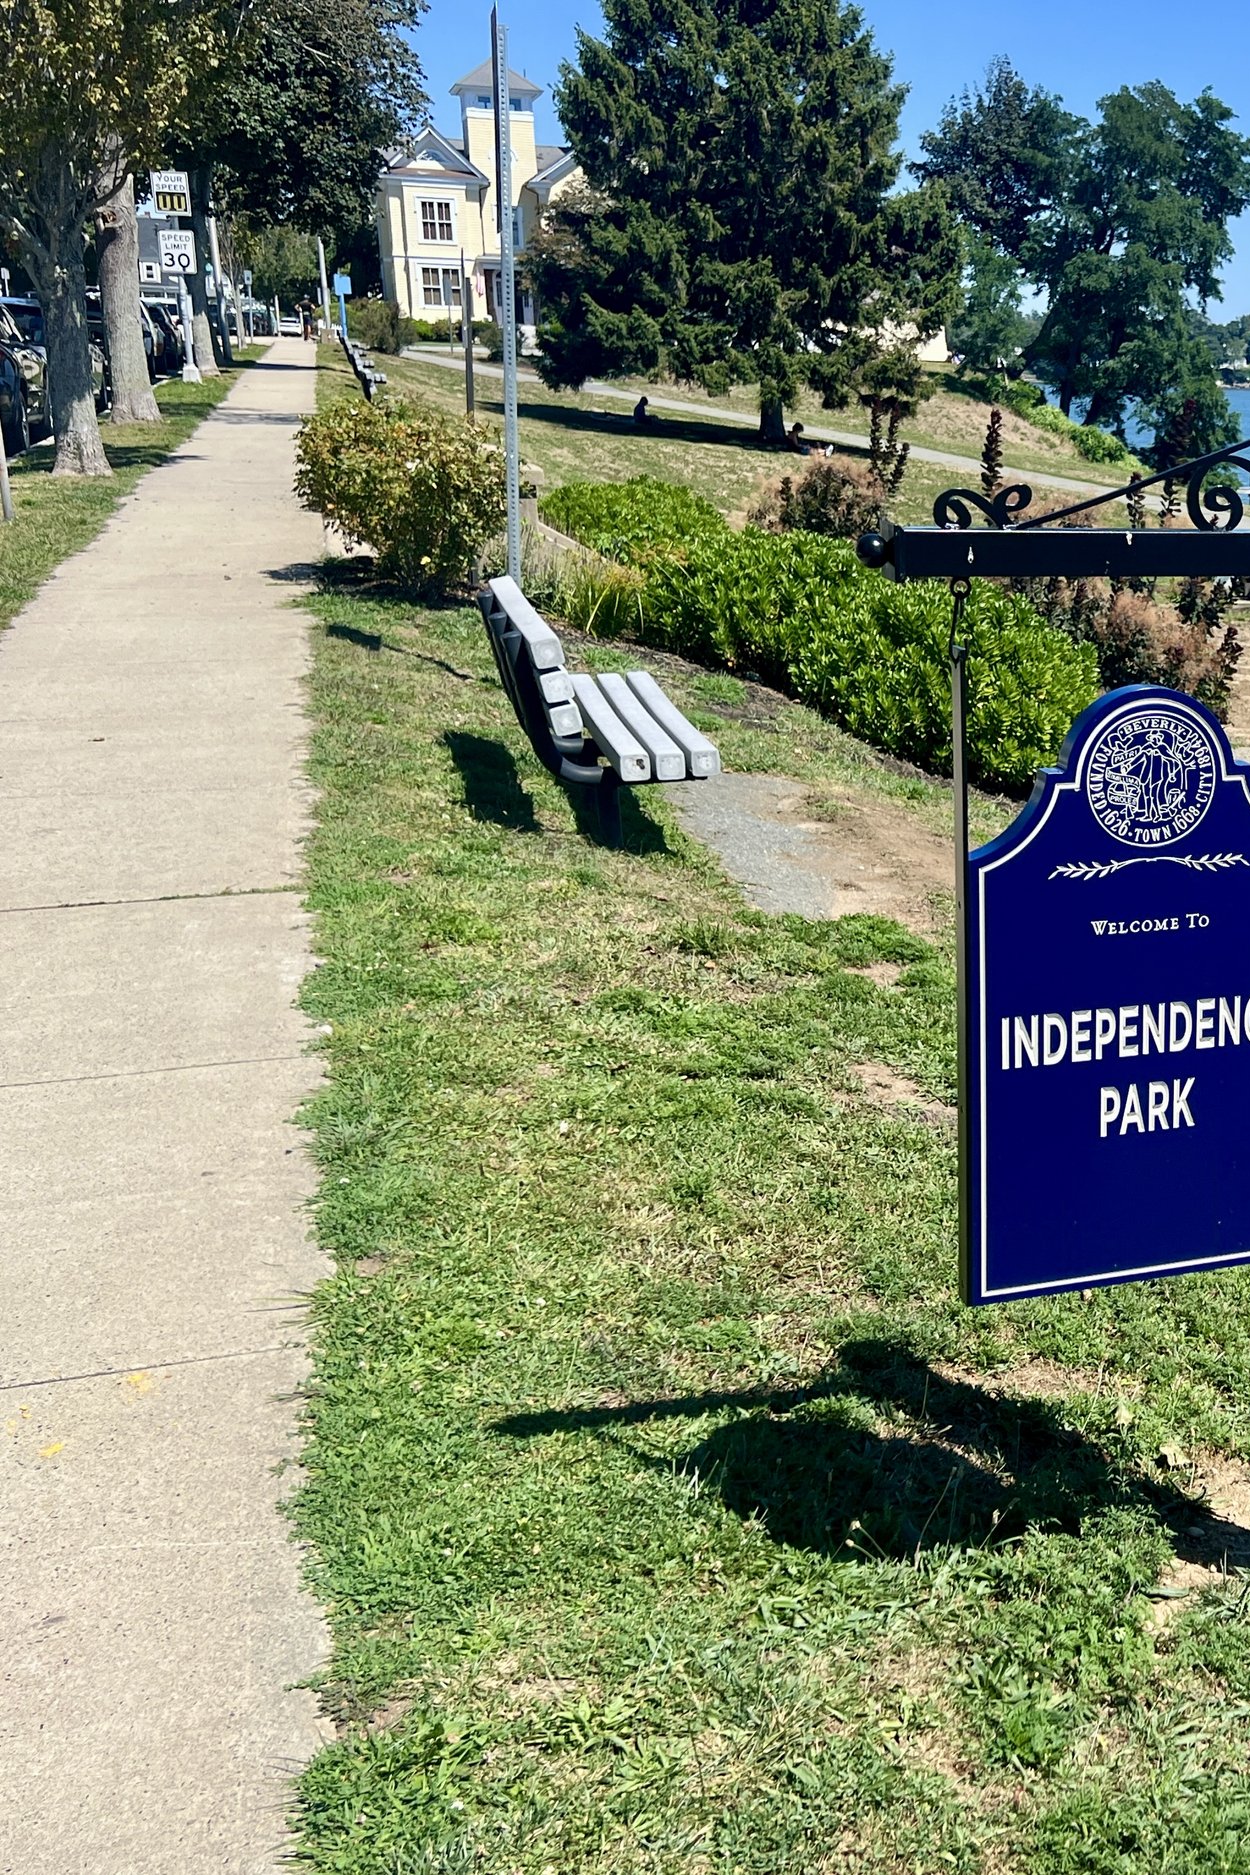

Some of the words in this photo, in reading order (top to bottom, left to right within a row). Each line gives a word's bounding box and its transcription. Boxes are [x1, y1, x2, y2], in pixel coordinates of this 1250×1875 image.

[157, 175, 183, 183] YOUR
[161, 234, 190, 242] SPEED
[164, 252, 190, 268] 30
[1123, 718, 1183, 735] BEVERLY
[1195, 771, 1212, 802] CITY
[1100, 808, 1130, 836] 1626
[1134, 825, 1171, 842] TOWN
[1172, 807, 1200, 833] 1668
[1100, 1077, 1196, 1138] PARK
